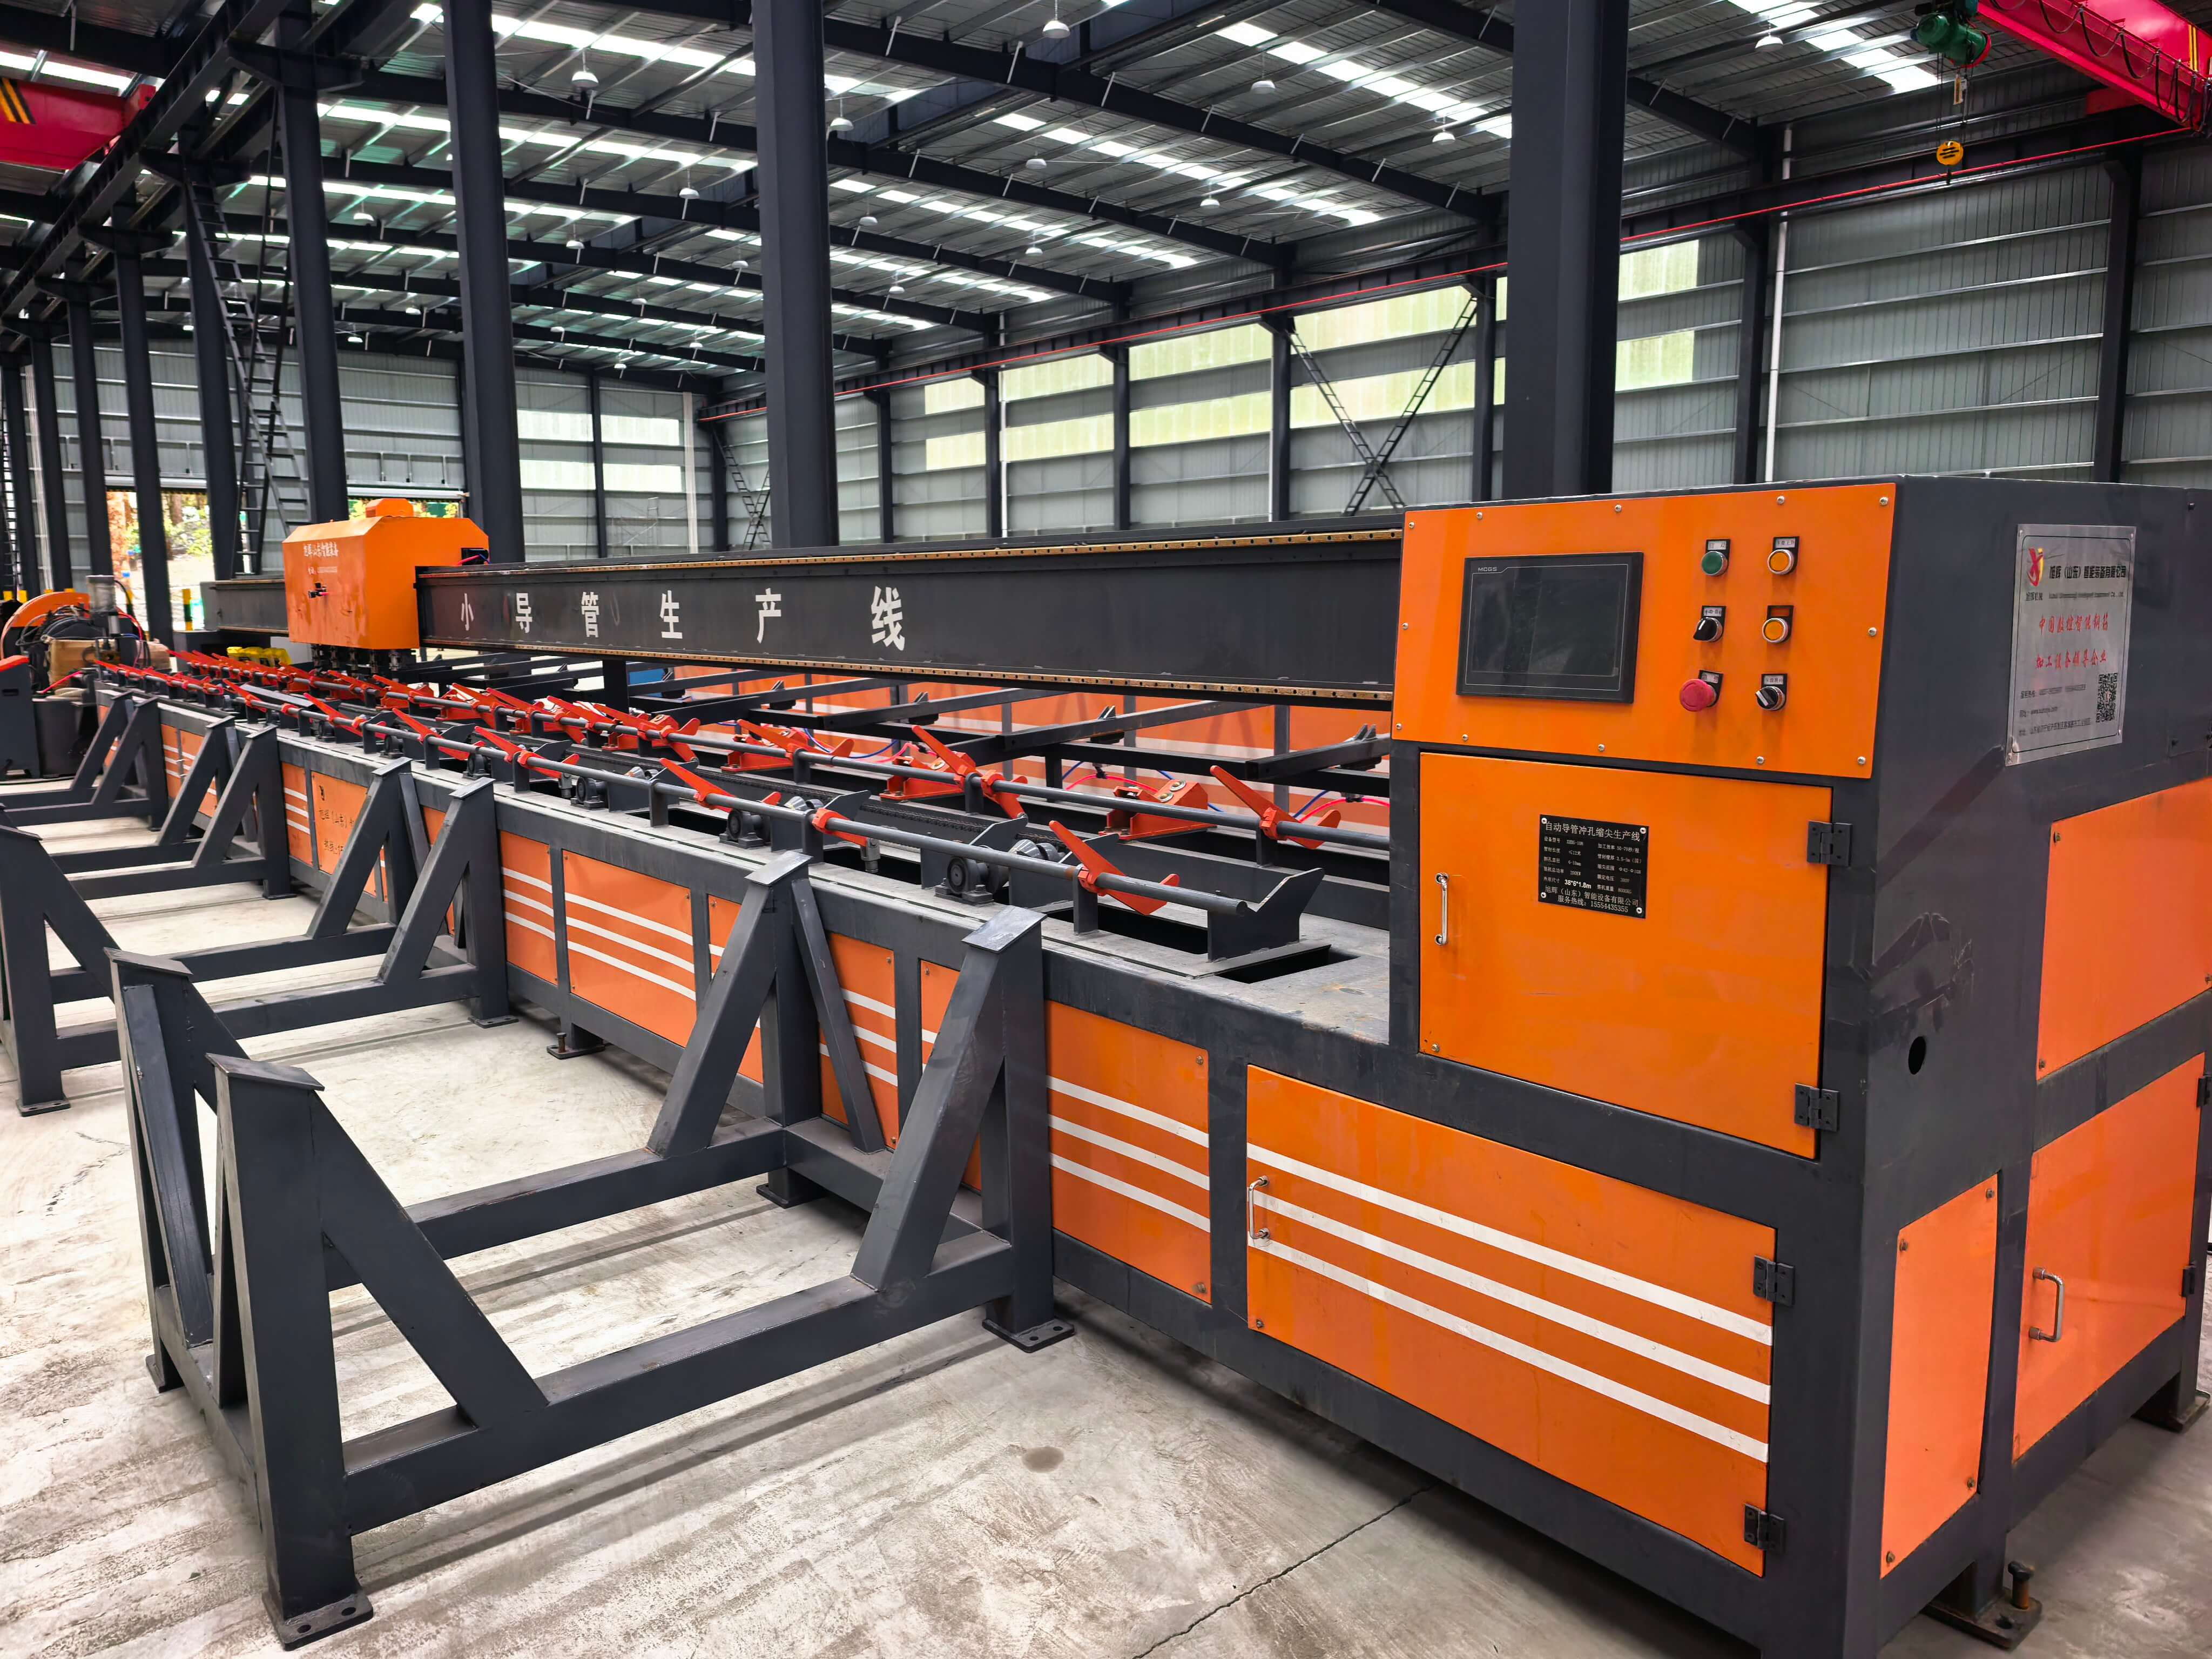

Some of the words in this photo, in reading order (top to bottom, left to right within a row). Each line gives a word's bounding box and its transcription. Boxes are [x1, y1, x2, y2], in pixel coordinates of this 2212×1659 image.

[461, 585, 906, 651] 小导管生产线
[1546, 821, 1640, 842] 自动导管冲孔缩尖生产线
